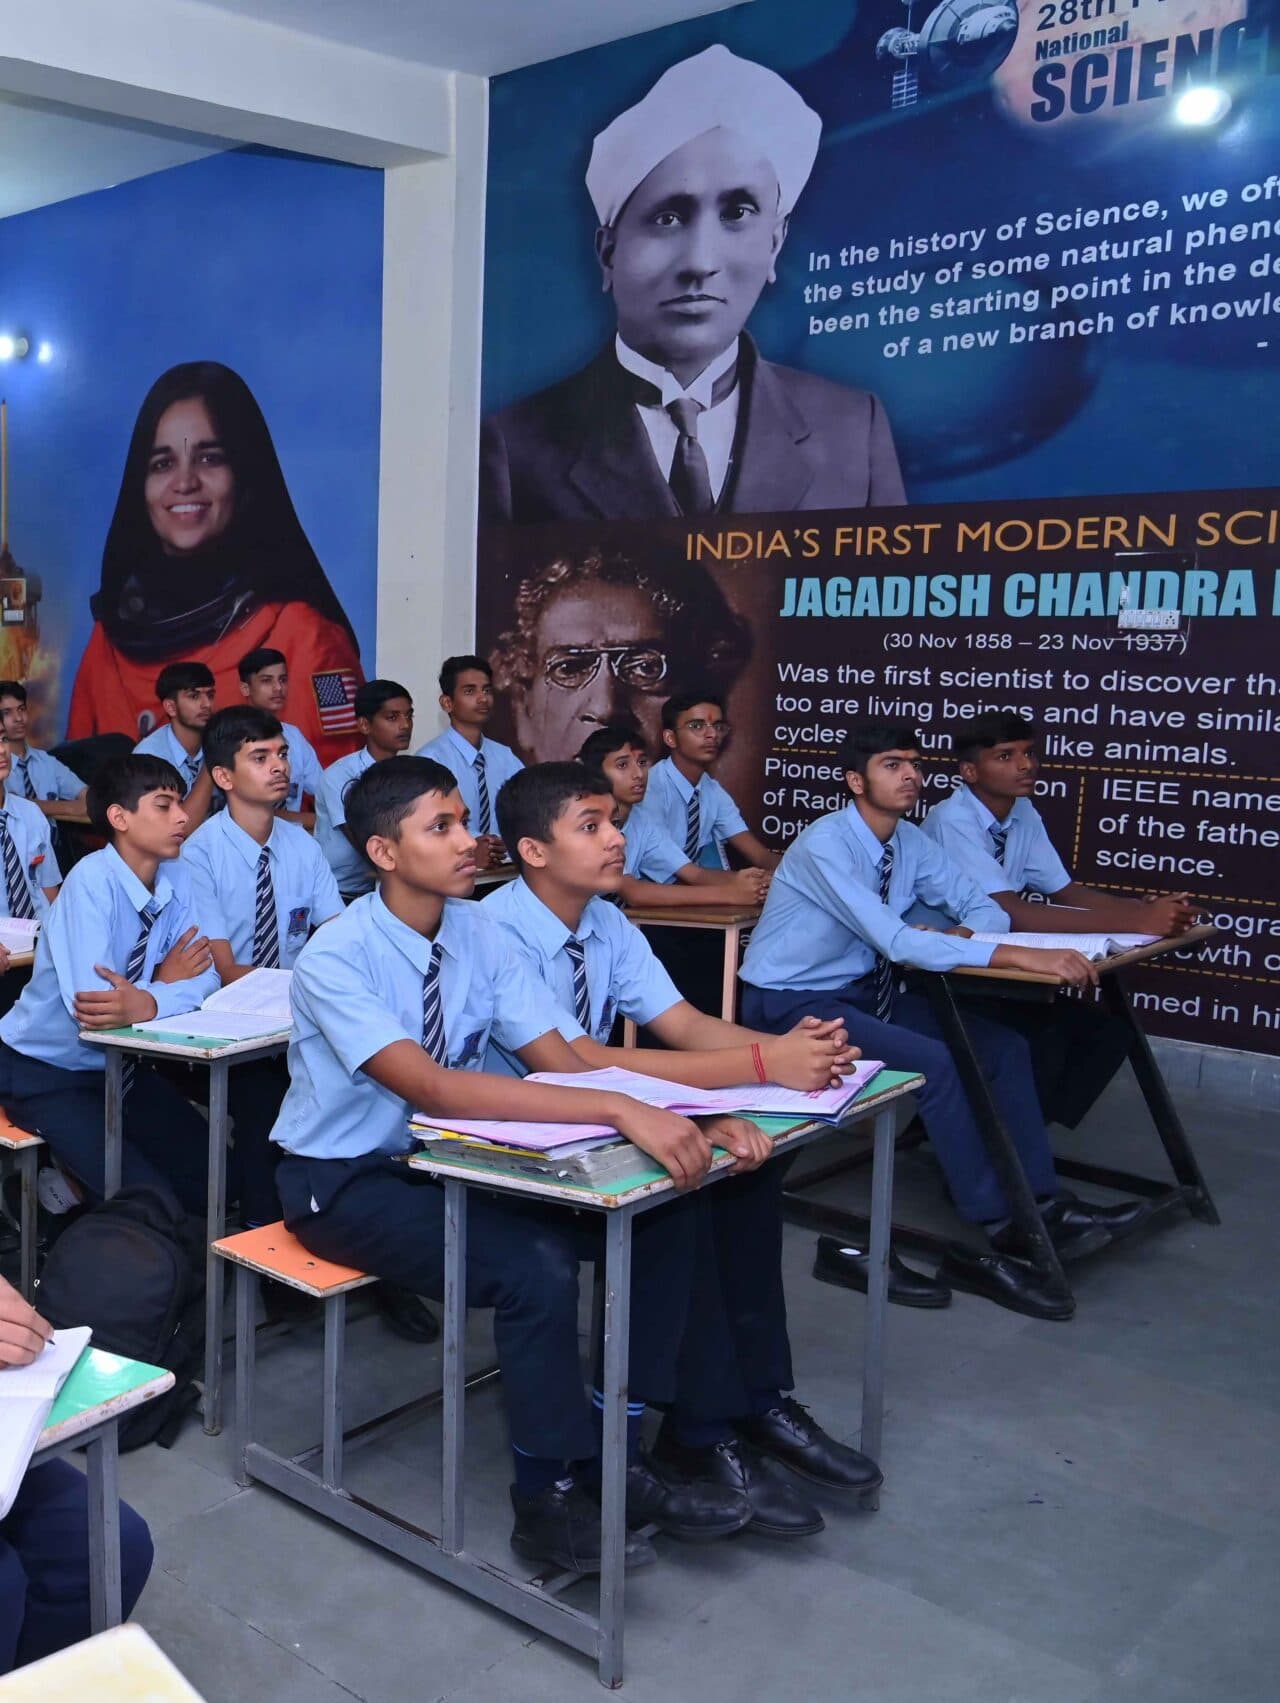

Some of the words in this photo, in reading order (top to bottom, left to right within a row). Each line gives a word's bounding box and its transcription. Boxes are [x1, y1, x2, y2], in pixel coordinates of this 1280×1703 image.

[1035, 20, 1129, 61] National
[808, 252, 831, 272] In
[839, 246, 880, 266] the
[889, 228, 986, 259] history
[996, 216, 1027, 241] of
[1035, 200, 1168, 236] Science,
[1181, 188, 1228, 212] we
[803, 282, 842, 304] the
[851, 270, 926, 297] study
[934, 262, 964, 284] of
[971, 252, 1050, 280] some
[1061, 229, 1173, 267] natural
[809, 312, 870, 336] been
[878, 304, 920, 326] the
[929, 289, 1040, 320] starting
[1051, 273, 1132, 309] point
[1142, 269, 1171, 292] in
[1183, 261, 1237, 286] the
[882, 336, 910, 358] of
[918, 338, 932, 354] a
[942, 329, 1000, 352] new
[1009, 312, 1114, 344] branch
[1126, 305, 1160, 330] of
[686, 528, 820, 561] INDIA'S
[834, 523, 942, 557] FIRST
[957, 514, 1177, 552] MODERN
[1196, 510, 1279, 547] SCI
[780, 574, 992, 618] JAGADISH
[1003, 569, 1257, 618] CHANDRA
[883, 633, 912, 652] (30
[920, 633, 958, 650] Nov
[964, 634, 1012, 650] 1858
[1038, 634, 1064, 650] 23
[1072, 634, 1114, 651] Nov
[1120, 634, 1188, 656] 1937)
[777, 662, 829, 684] Was
[837, 664, 876, 685] the
[884, 665, 932, 686] first
[939, 668, 1054, 690] scientist
[1062, 669, 1090, 690] to
[1100, 670, 1236, 694] discover
[1246, 673, 1280, 696] th
[776, 694, 812, 712] too
[820, 698, 860, 714] are
[868, 696, 932, 722] living
[1044, 704, 1098, 724] and
[1110, 704, 1186, 728] have
[774, 724, 848, 746] cycles
[1044, 734, 1095, 758] like
[1104, 739, 1237, 766] animals.
[763, 789, 786, 806] of
[792, 790, 854, 810] Radi
[1102, 778, 1180, 805] IEEE
[1098, 814, 1130, 834] of
[1137, 816, 1186, 839] the
[1096, 848, 1224, 878] science.
[1212, 998, 1239, 1024] in
